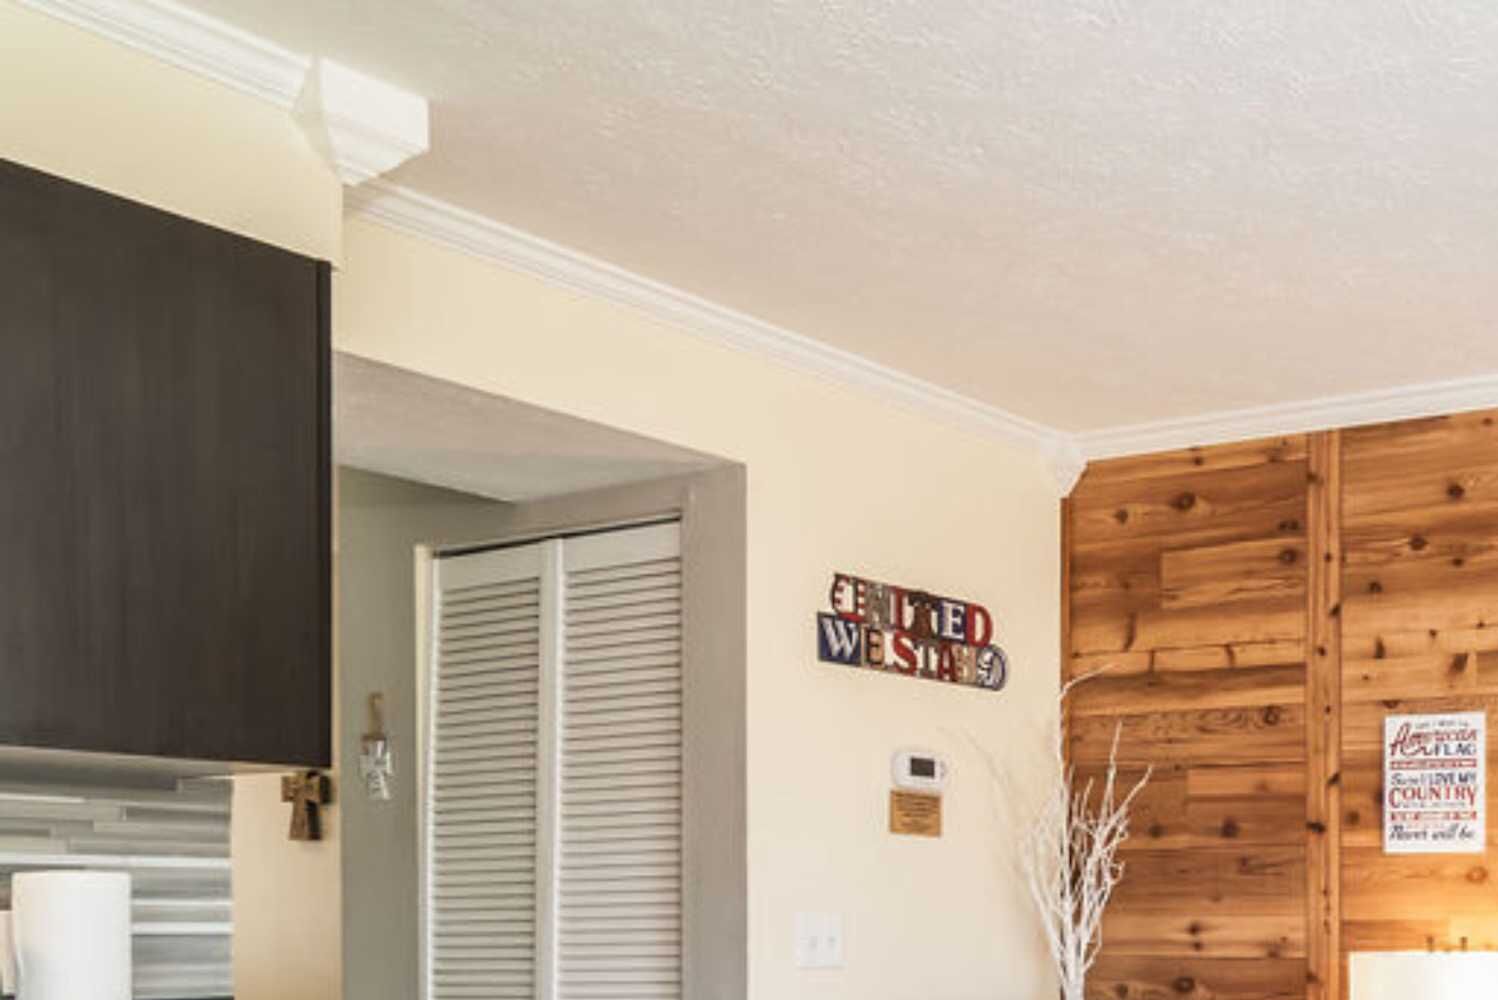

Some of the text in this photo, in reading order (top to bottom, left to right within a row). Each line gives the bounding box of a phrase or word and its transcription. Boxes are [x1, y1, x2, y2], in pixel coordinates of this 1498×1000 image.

[831, 573, 993, 648] UNITED
[817, 612, 885, 670] WE
[1389, 784, 1477, 809] COUNTRY
